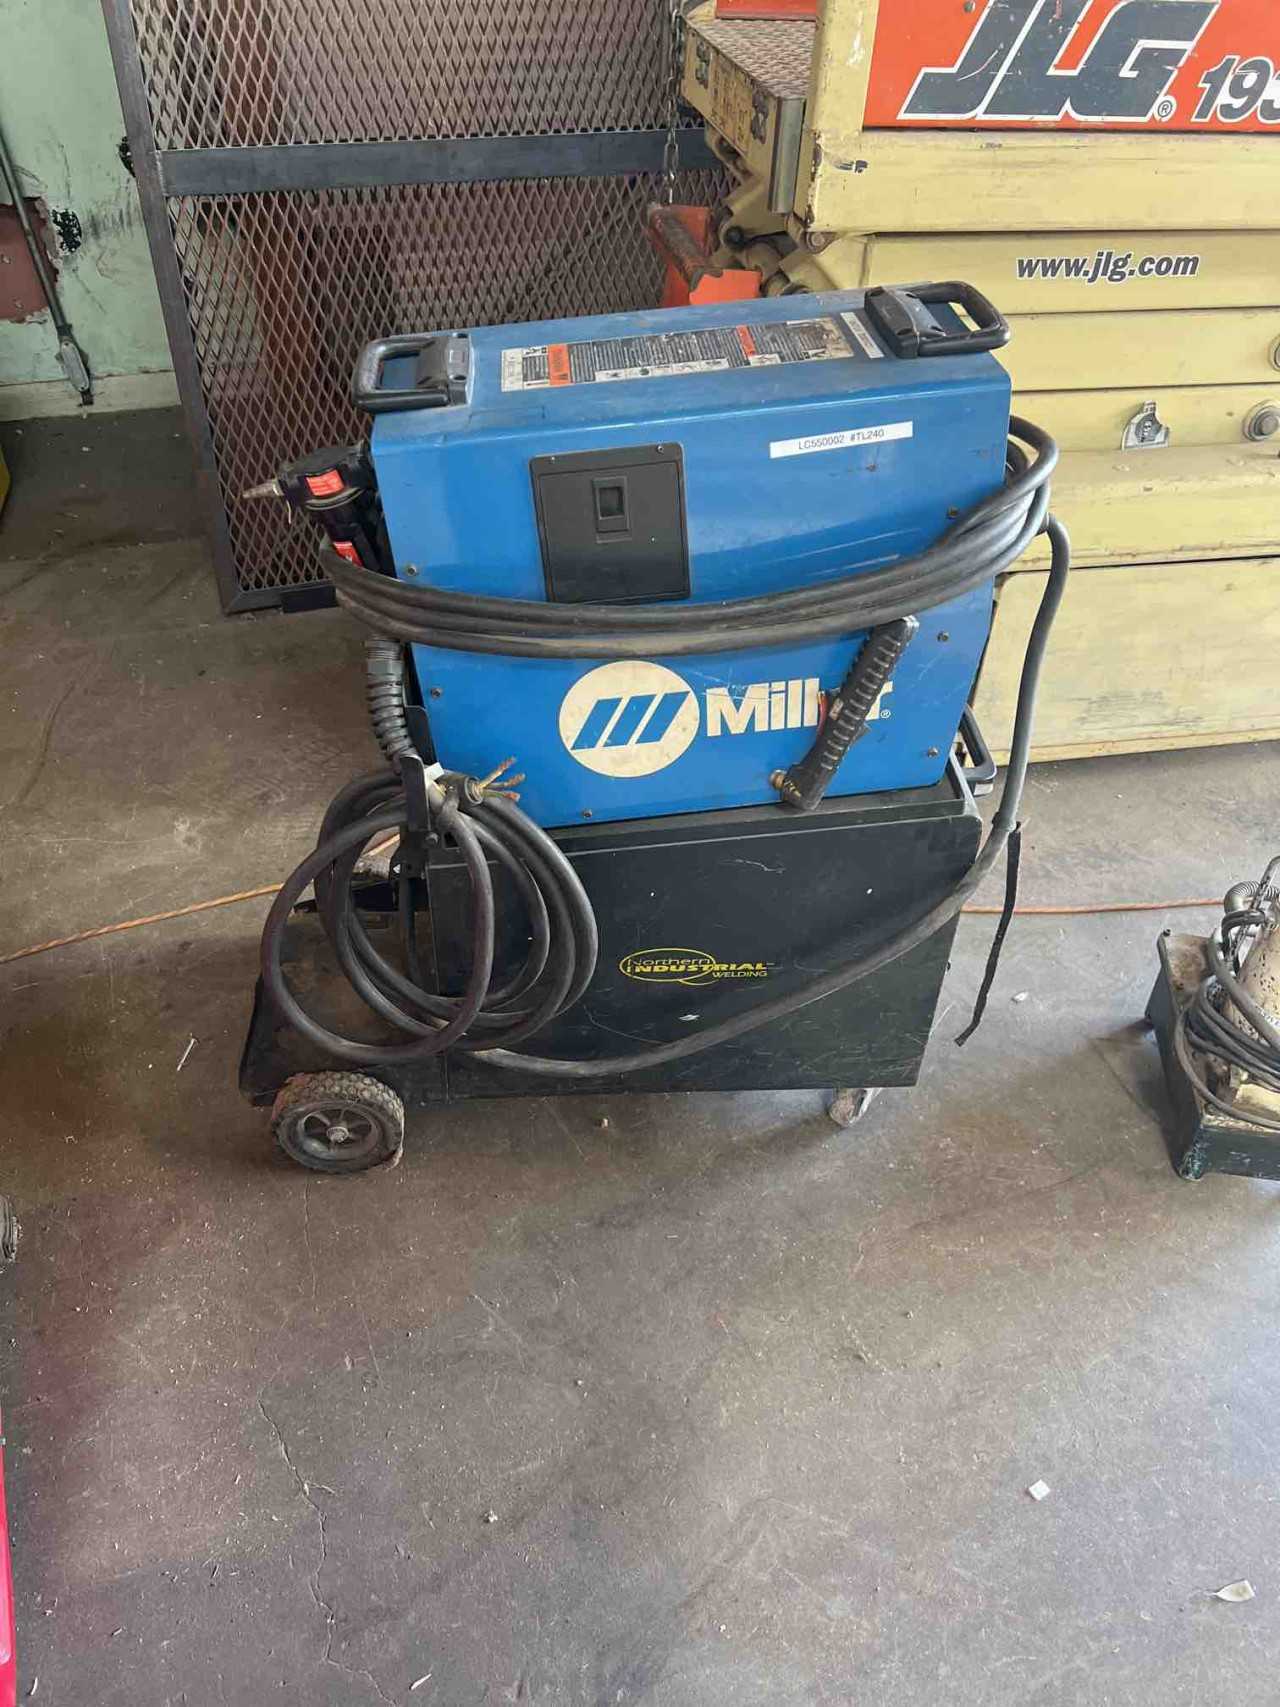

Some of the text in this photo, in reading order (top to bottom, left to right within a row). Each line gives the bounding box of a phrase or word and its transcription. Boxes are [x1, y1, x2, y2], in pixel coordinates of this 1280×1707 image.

[896, 0, 1222, 121] JLG
[1017, 250, 1200, 283] www.jlg.com
[850, 428, 885, 442] #TL240
[706, 678, 893, 737] Millr
[626, 962, 768, 973] INDUSTRIAL
[627, 958, 711, 966] Northern
